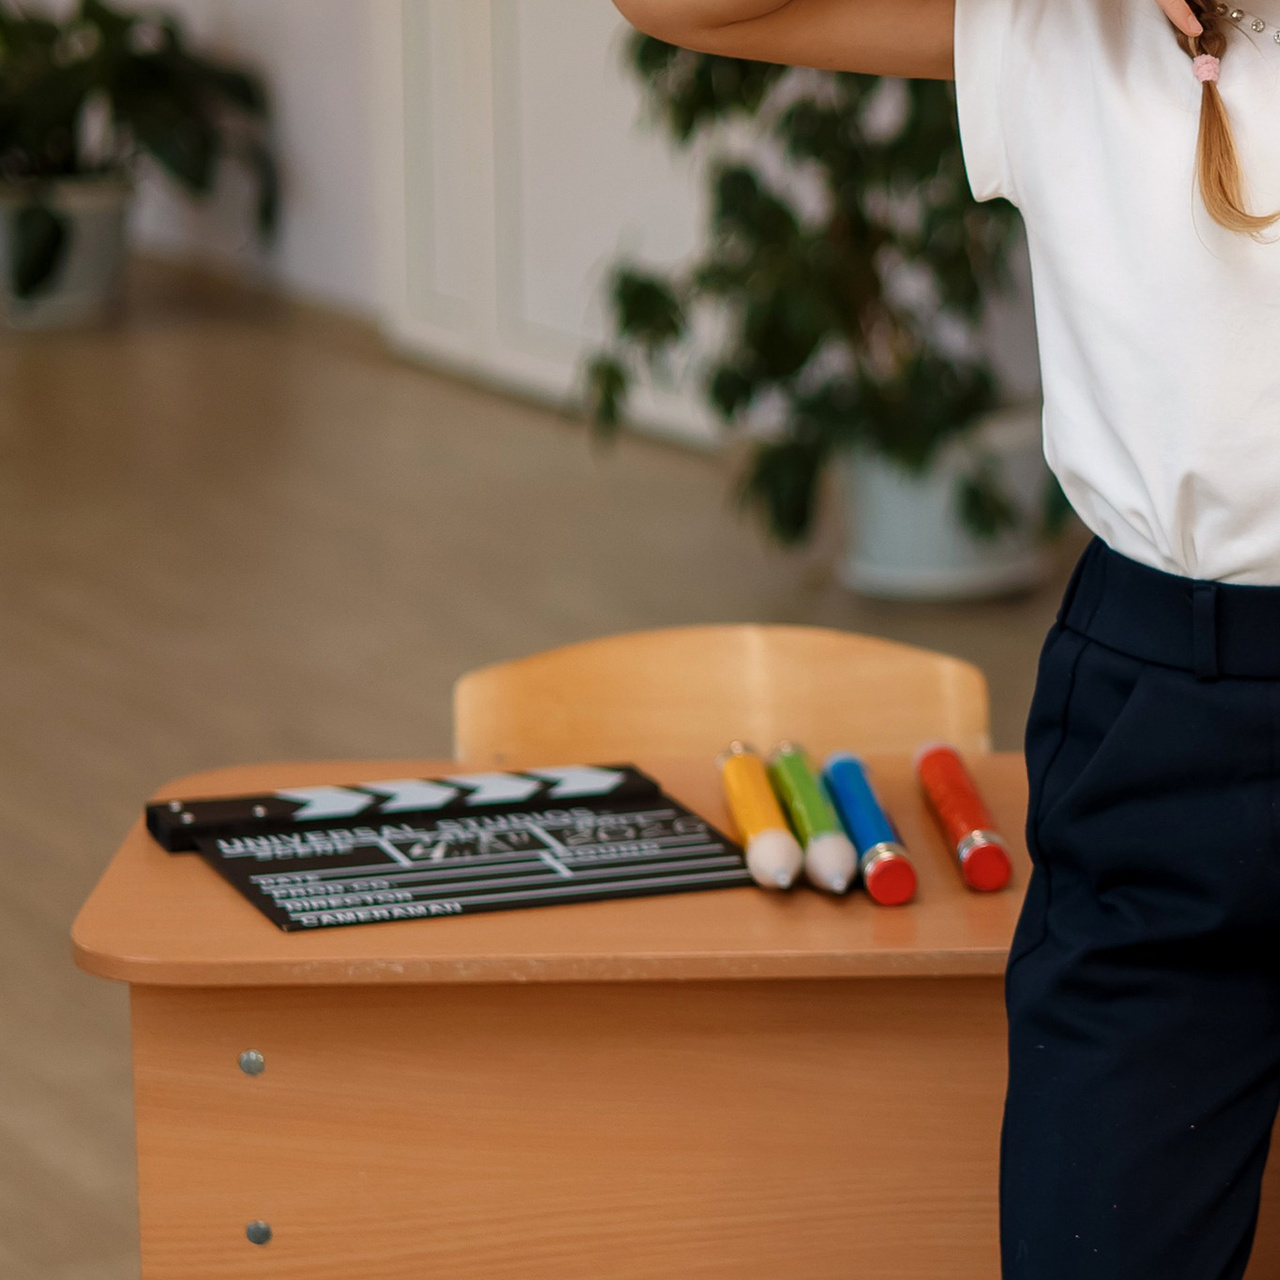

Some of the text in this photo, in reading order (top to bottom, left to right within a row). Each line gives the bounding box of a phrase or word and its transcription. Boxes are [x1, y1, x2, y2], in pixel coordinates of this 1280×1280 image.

[216, 823, 428, 858] UNIVERSAL
[285, 891, 413, 911] DIRECTOR
[300, 902, 463, 927] CAMERAMAN
